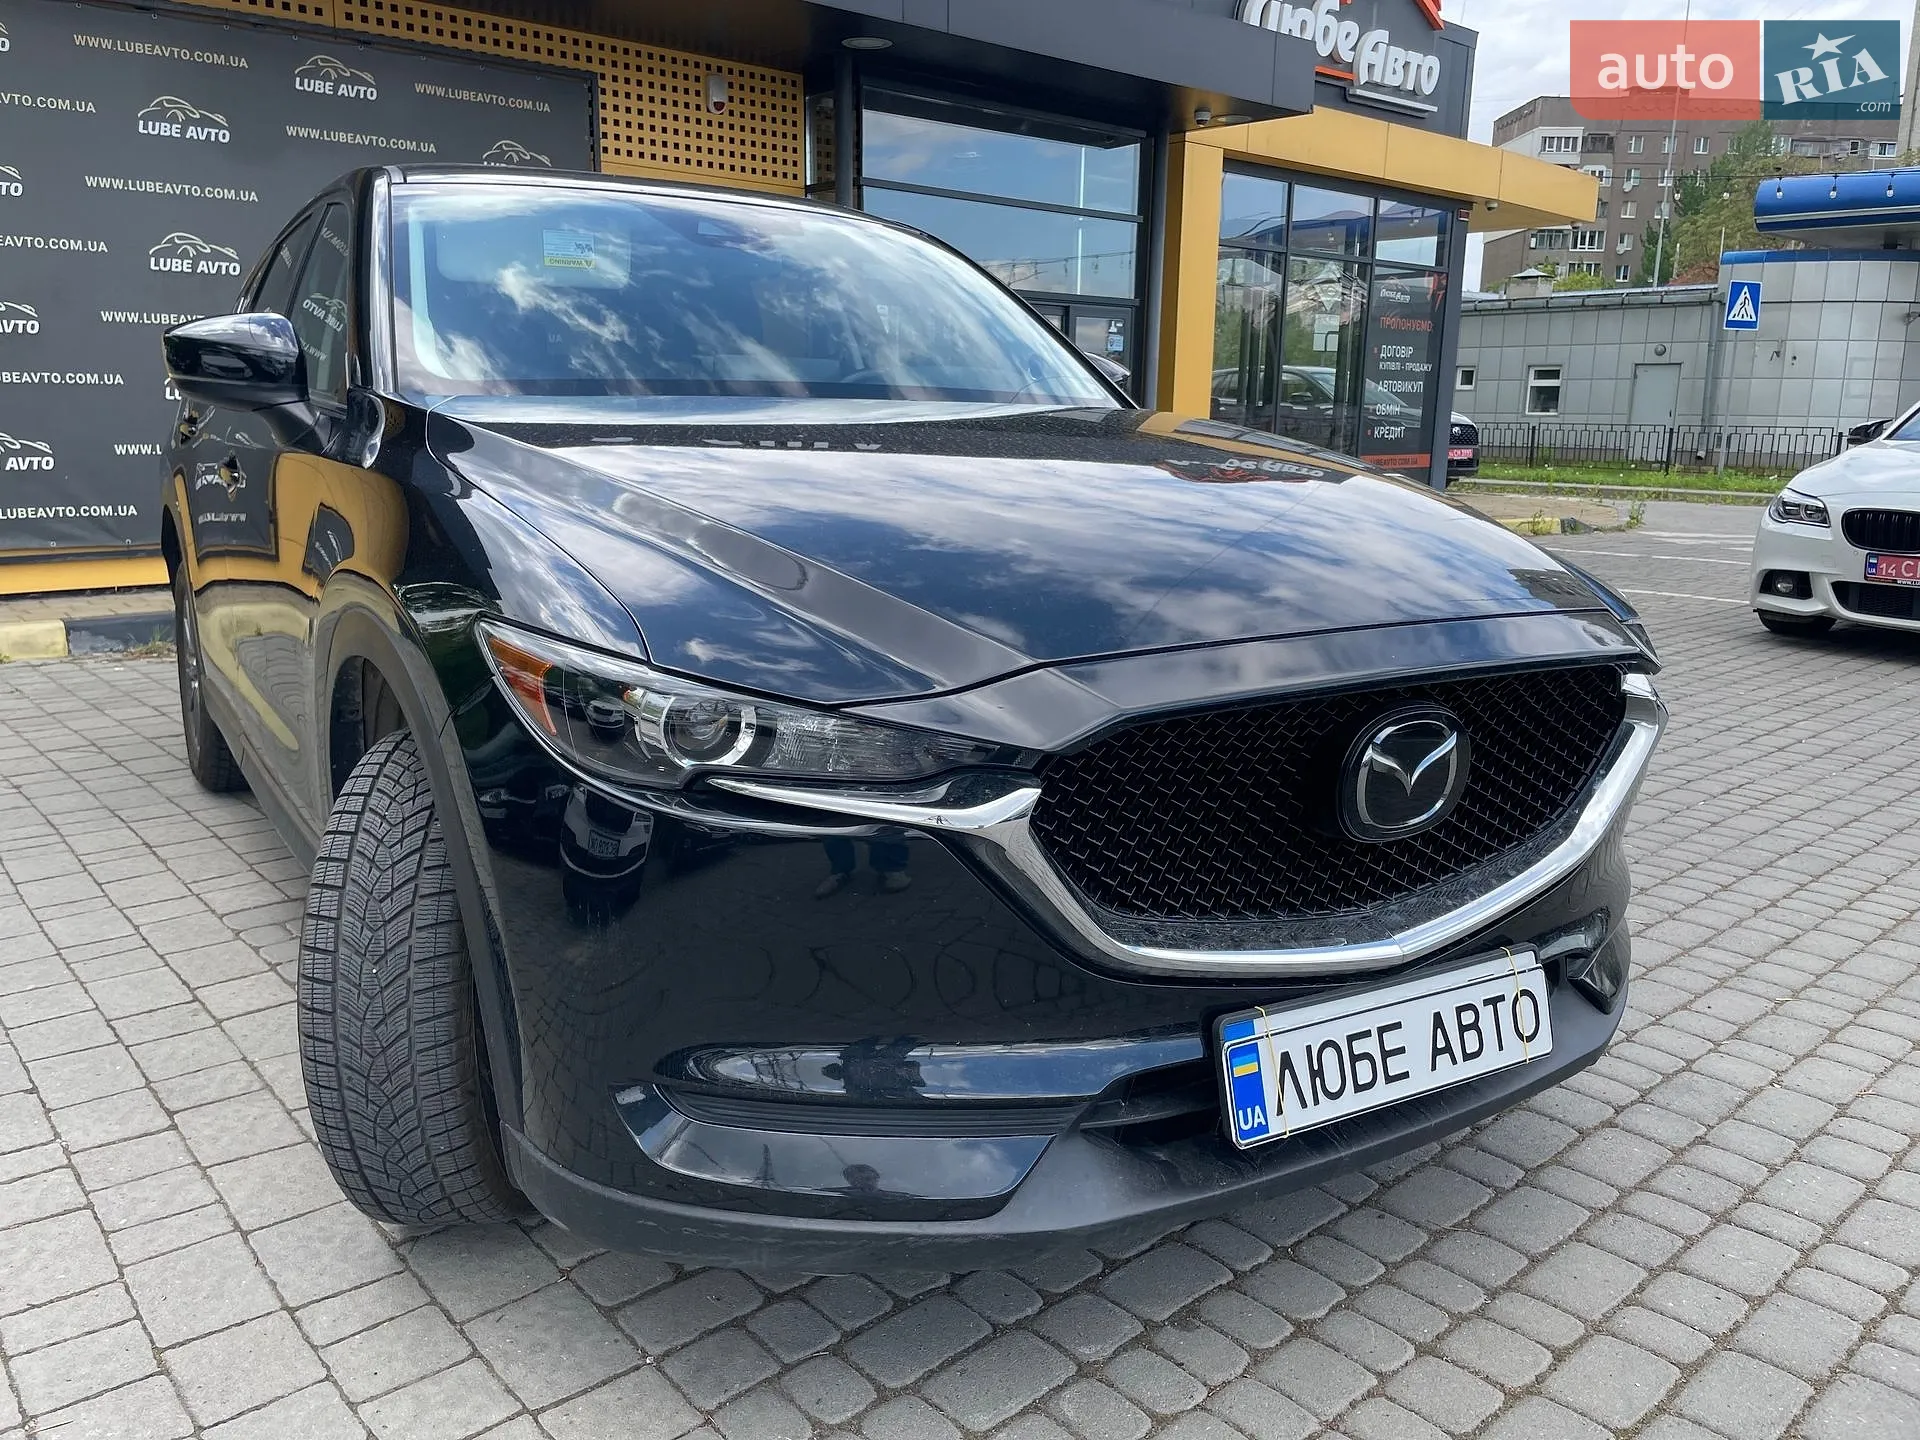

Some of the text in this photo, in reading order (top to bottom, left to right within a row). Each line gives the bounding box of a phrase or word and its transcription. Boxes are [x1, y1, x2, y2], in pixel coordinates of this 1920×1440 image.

[73, 33, 249, 69] WWW.LUBEAVTO.COM.UA
[295, 77, 377, 101] LUBE AVTO
[414, 82, 551, 113] WWW.LUBEAVTO.COM.UA
[0, 92, 96, 114] VTO.COM.UA
[138, 120, 231, 144] LUBE AVTO
[286, 125, 437, 154] WWW.LUBEAVTO.COM.UA
[85, 175, 259, 203] WWW.LUBEAVTO.COM.UA
[150, 256, 241, 276] LUBE AVTO
[100, 310, 205, 325] WWW.LUBEAV
[1380, 345, 1414, 360] ДОГОВІР
[0, 371, 124, 385] BEAVTO.COM.UA
[1378, 381, 1424, 393] АВТОВИКУП
[1375, 403, 1400, 416] ОБМІН
[1374, 426, 1406, 441] КРЕДИТ
[5, 456, 55, 471] AVTO
[1880, 560, 1920, 578] 14 C
[1276, 988, 1541, 1117] ЛЮБЕ АВТО
[1237, 1105, 1267, 1131] UA
